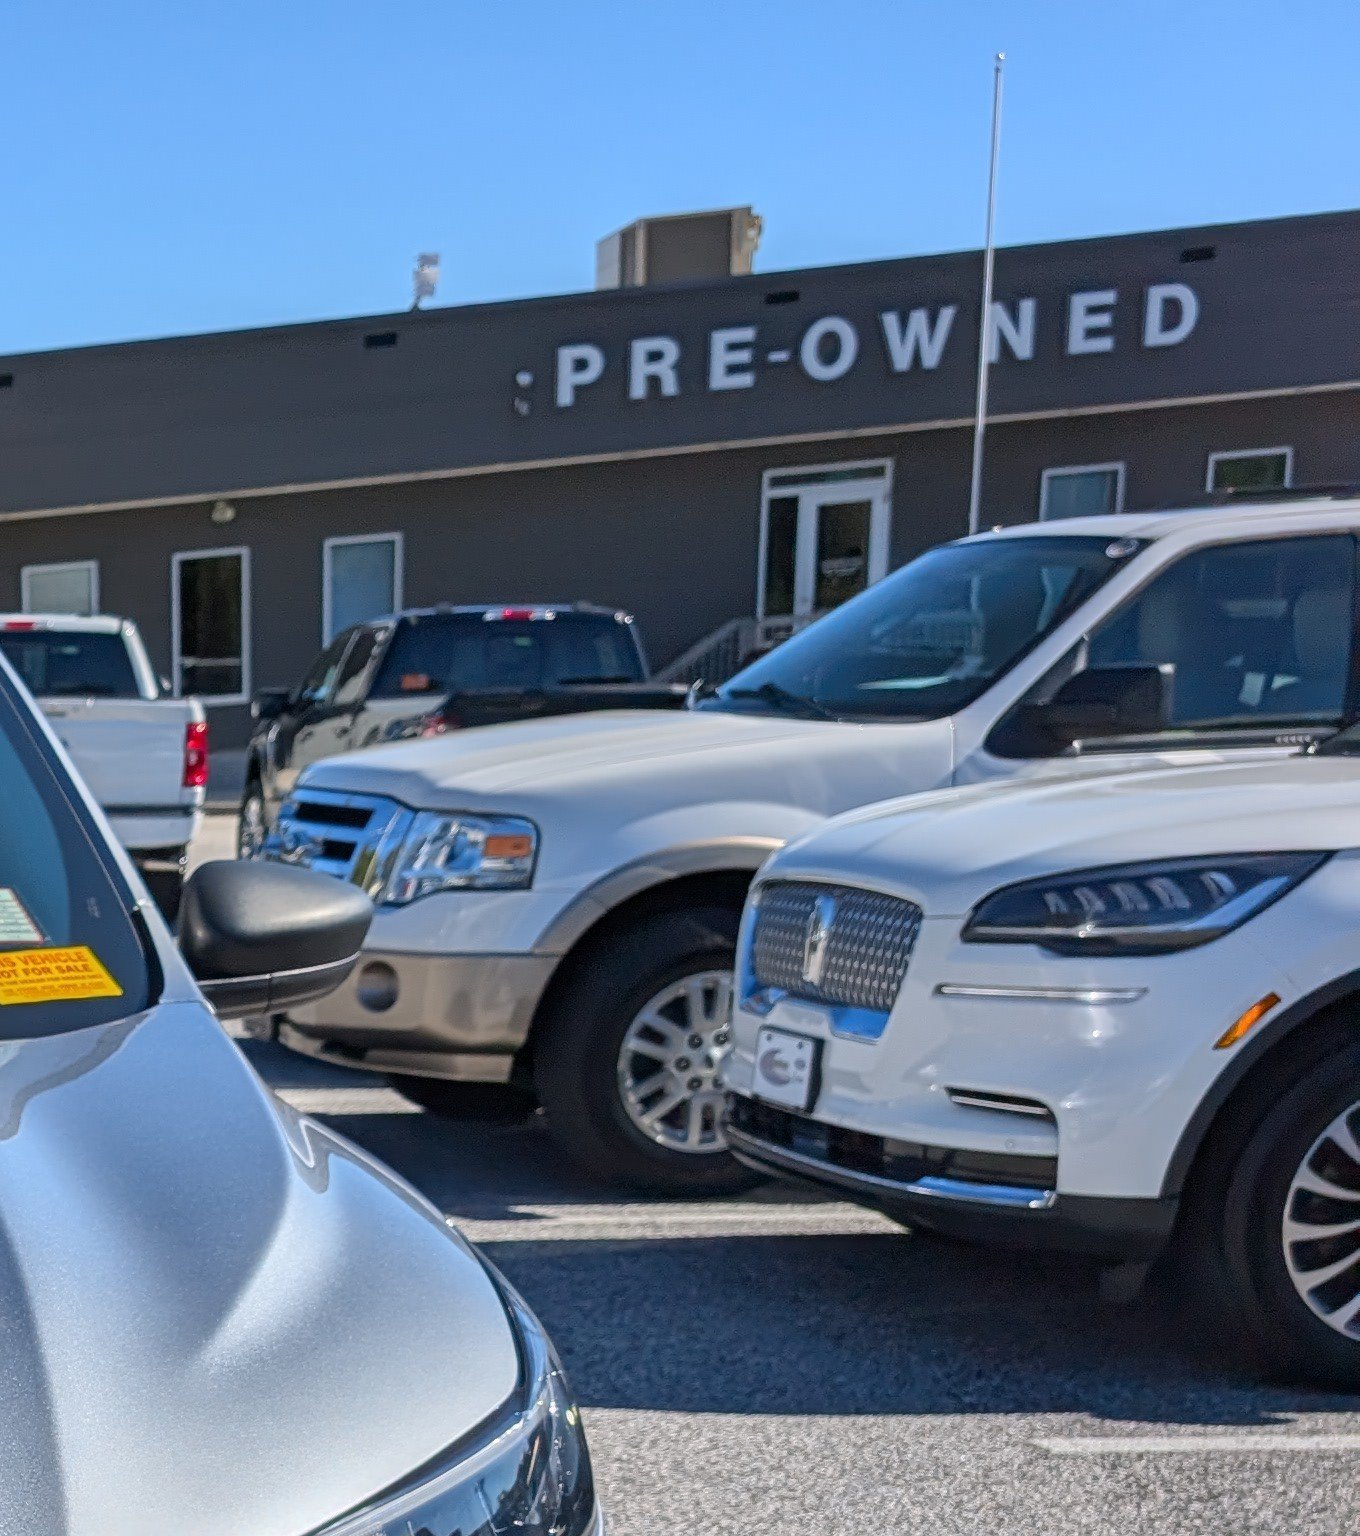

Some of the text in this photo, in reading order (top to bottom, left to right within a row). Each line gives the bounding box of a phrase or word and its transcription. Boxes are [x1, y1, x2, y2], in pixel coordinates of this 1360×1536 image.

[554, 281, 1201, 407] PRE-OWNED
[16, 951, 88, 966] VEHICLE
[22, 966, 53, 977] FOR
[55, 963, 93, 974] SALE
